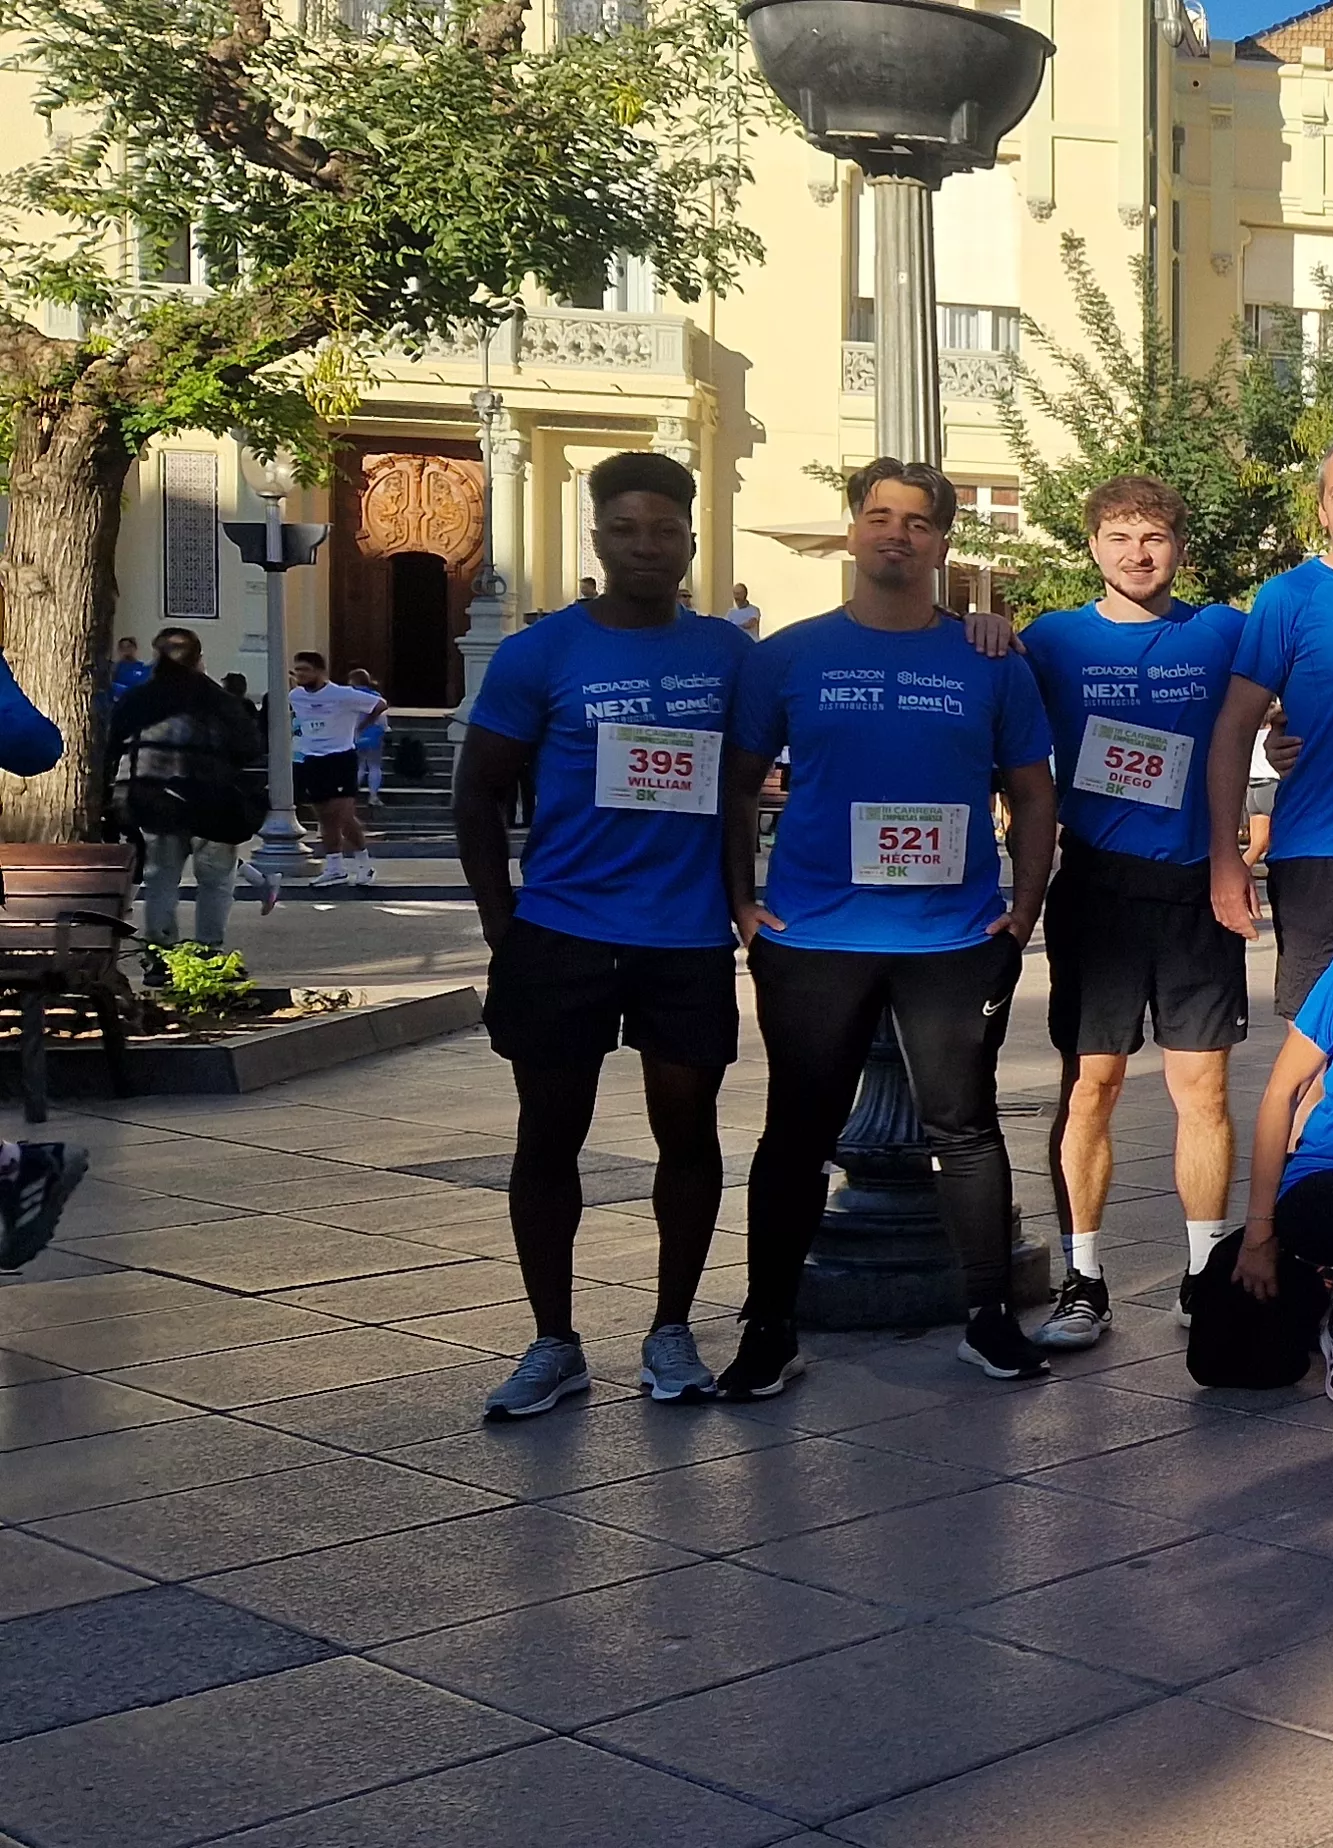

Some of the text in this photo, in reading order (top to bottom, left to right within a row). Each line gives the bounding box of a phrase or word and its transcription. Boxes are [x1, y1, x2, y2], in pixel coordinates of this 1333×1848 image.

[822, 670, 884, 680] MEDIAZION
[1082, 666, 1138, 675] MEDIAZION
[1161, 663, 1206, 679] kablex
[582, 680, 650, 695] MEDIAZION
[913, 672, 965, 691] kablex
[821, 688, 884, 702] NEXT
[1083, 684, 1138, 698] NEXT
[1151, 686, 1190, 699] HOME
[666, 700, 709, 712] HOME
[898, 695, 943, 706] HOME
[585, 698, 651, 719] NEXT
[628, 748, 692, 776] 395
[1104, 745, 1164, 777] 528
[628, 776, 692, 790] WILLIAM
[1110, 772, 1152, 789] DIEGO
[636, 789, 657, 801] 8K
[1105, 782, 1125, 796] 8K
[879, 827, 939, 850] 521
[887, 866, 908, 877] 8K
